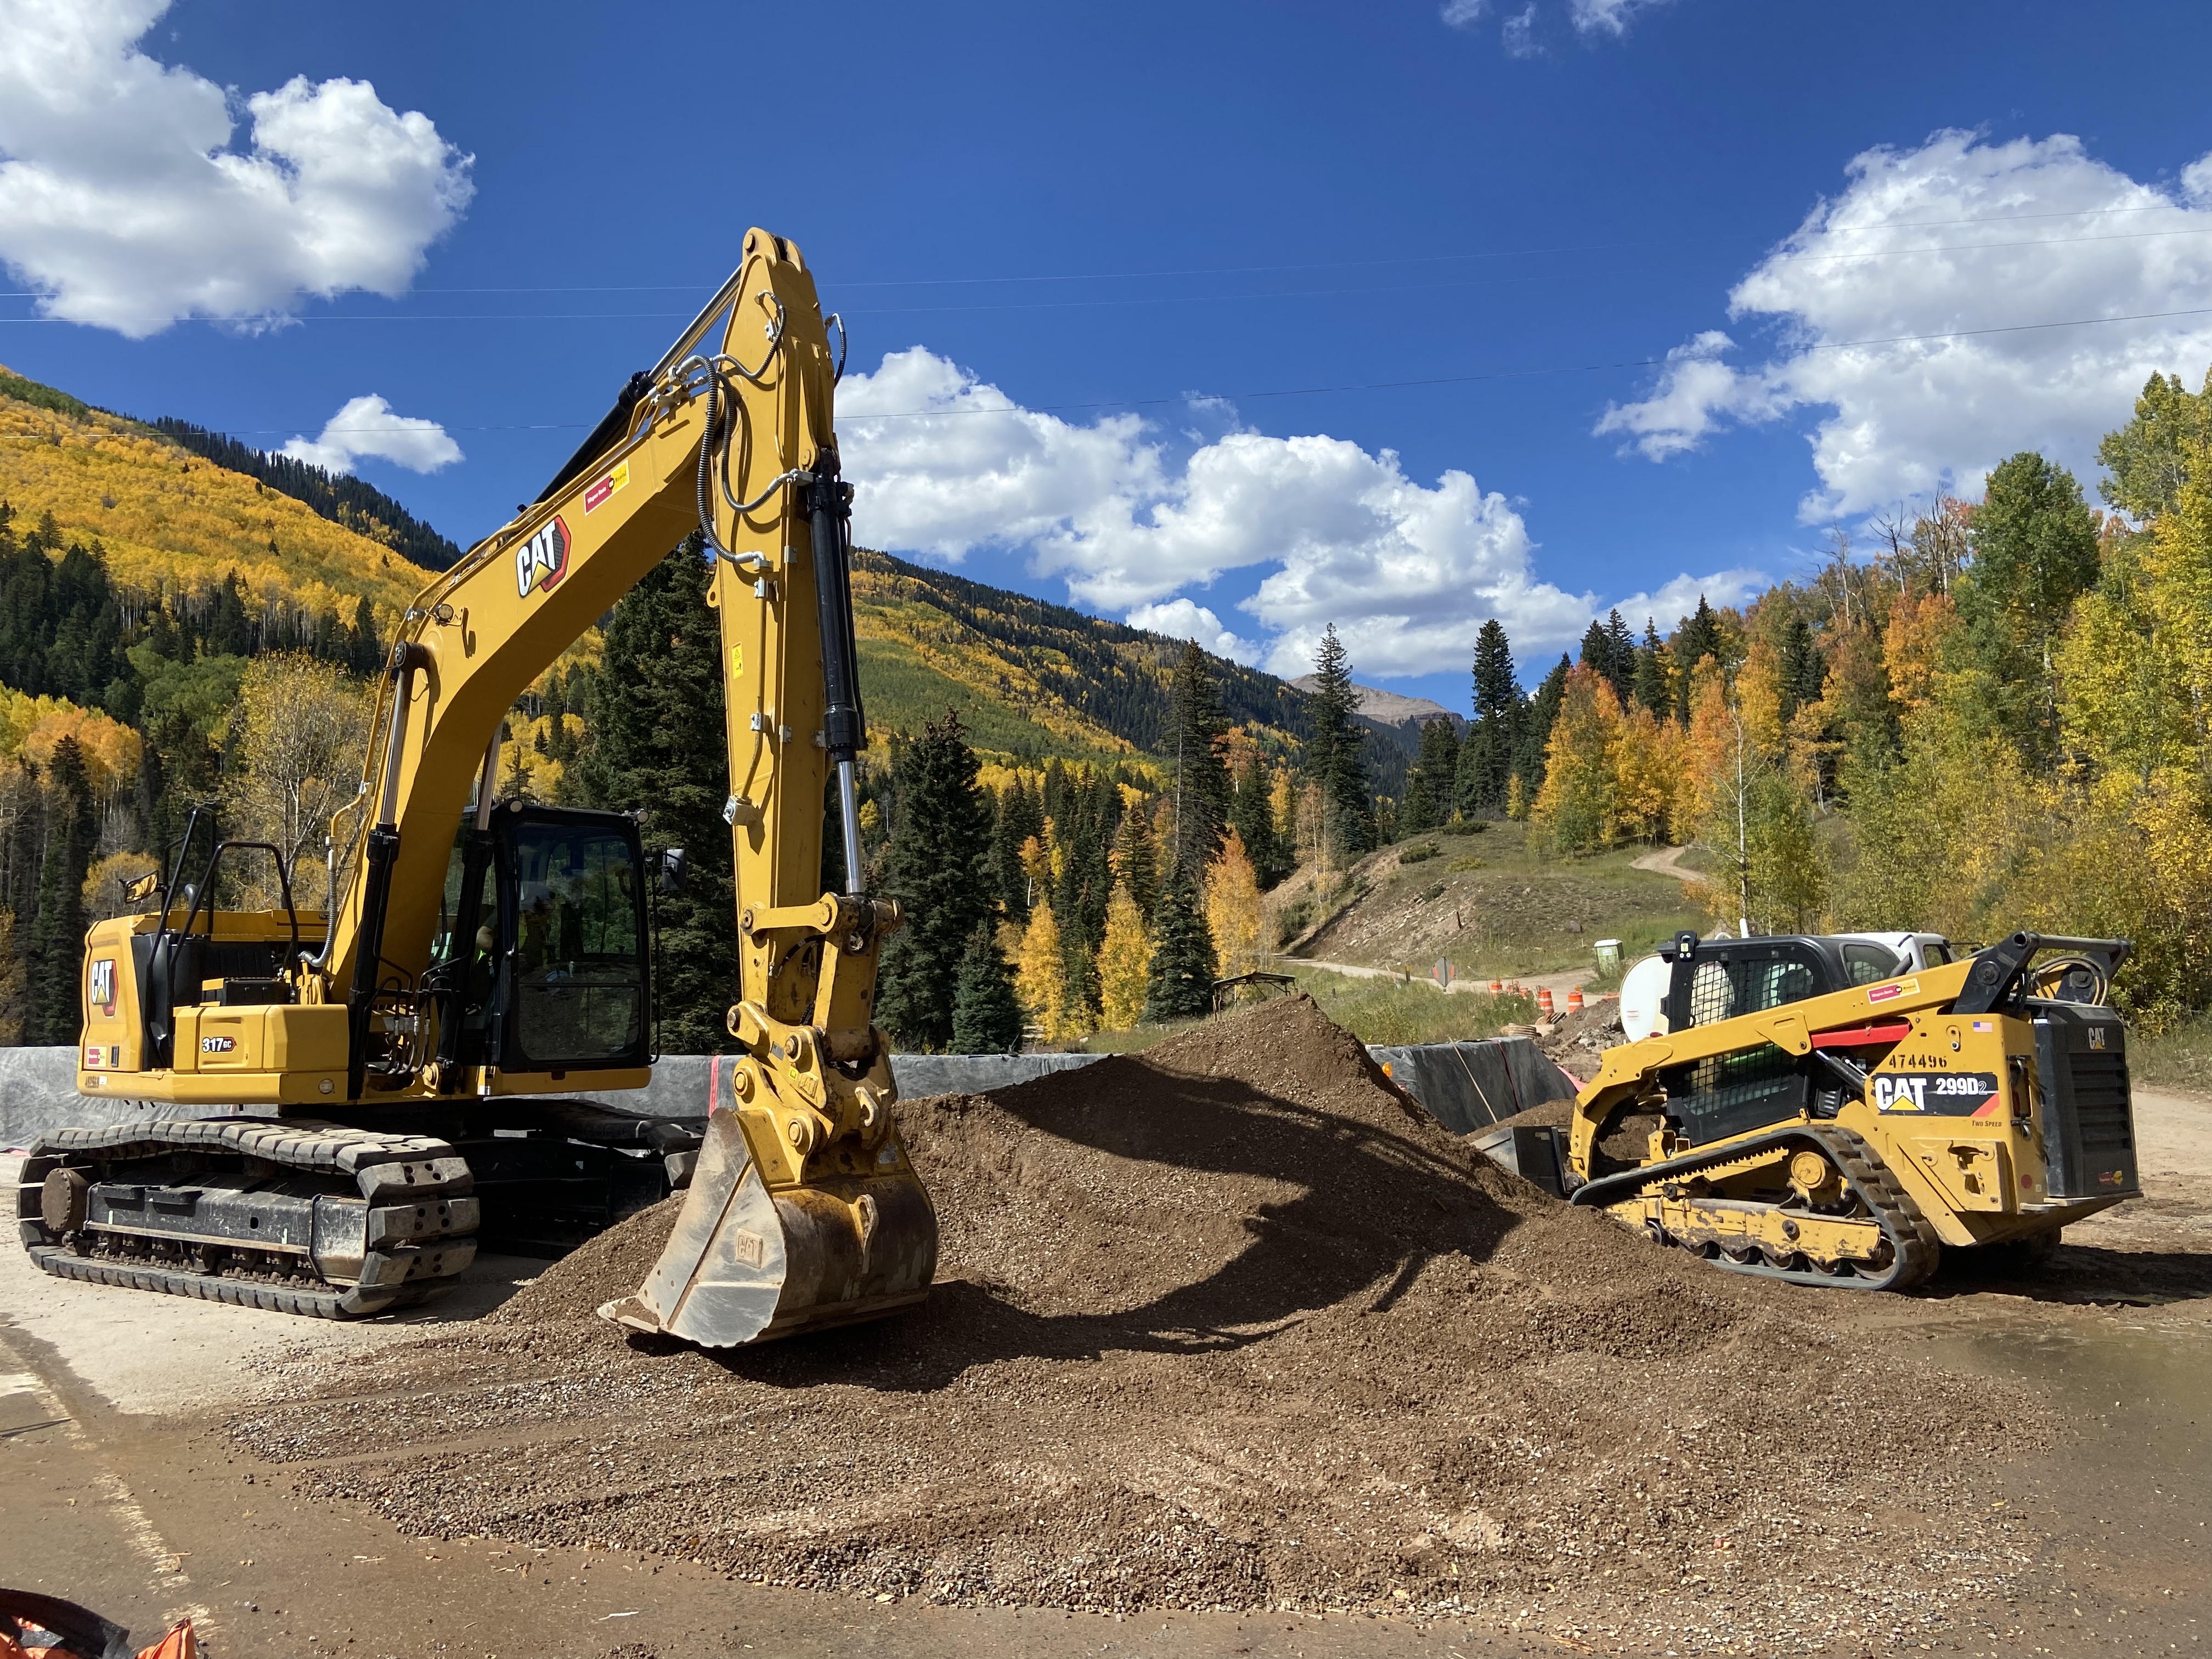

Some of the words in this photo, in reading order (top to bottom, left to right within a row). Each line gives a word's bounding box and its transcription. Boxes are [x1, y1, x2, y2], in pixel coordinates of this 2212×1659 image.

[517, 520, 556, 596] CAT
[92, 960, 112, 1004] CAT
[2088, 1027, 2106, 1049] CAT
[1889, 1054, 1948, 1069] 474496
[1875, 1077, 1927, 1111] CAT
[737, 1235, 759, 1262] CAT
